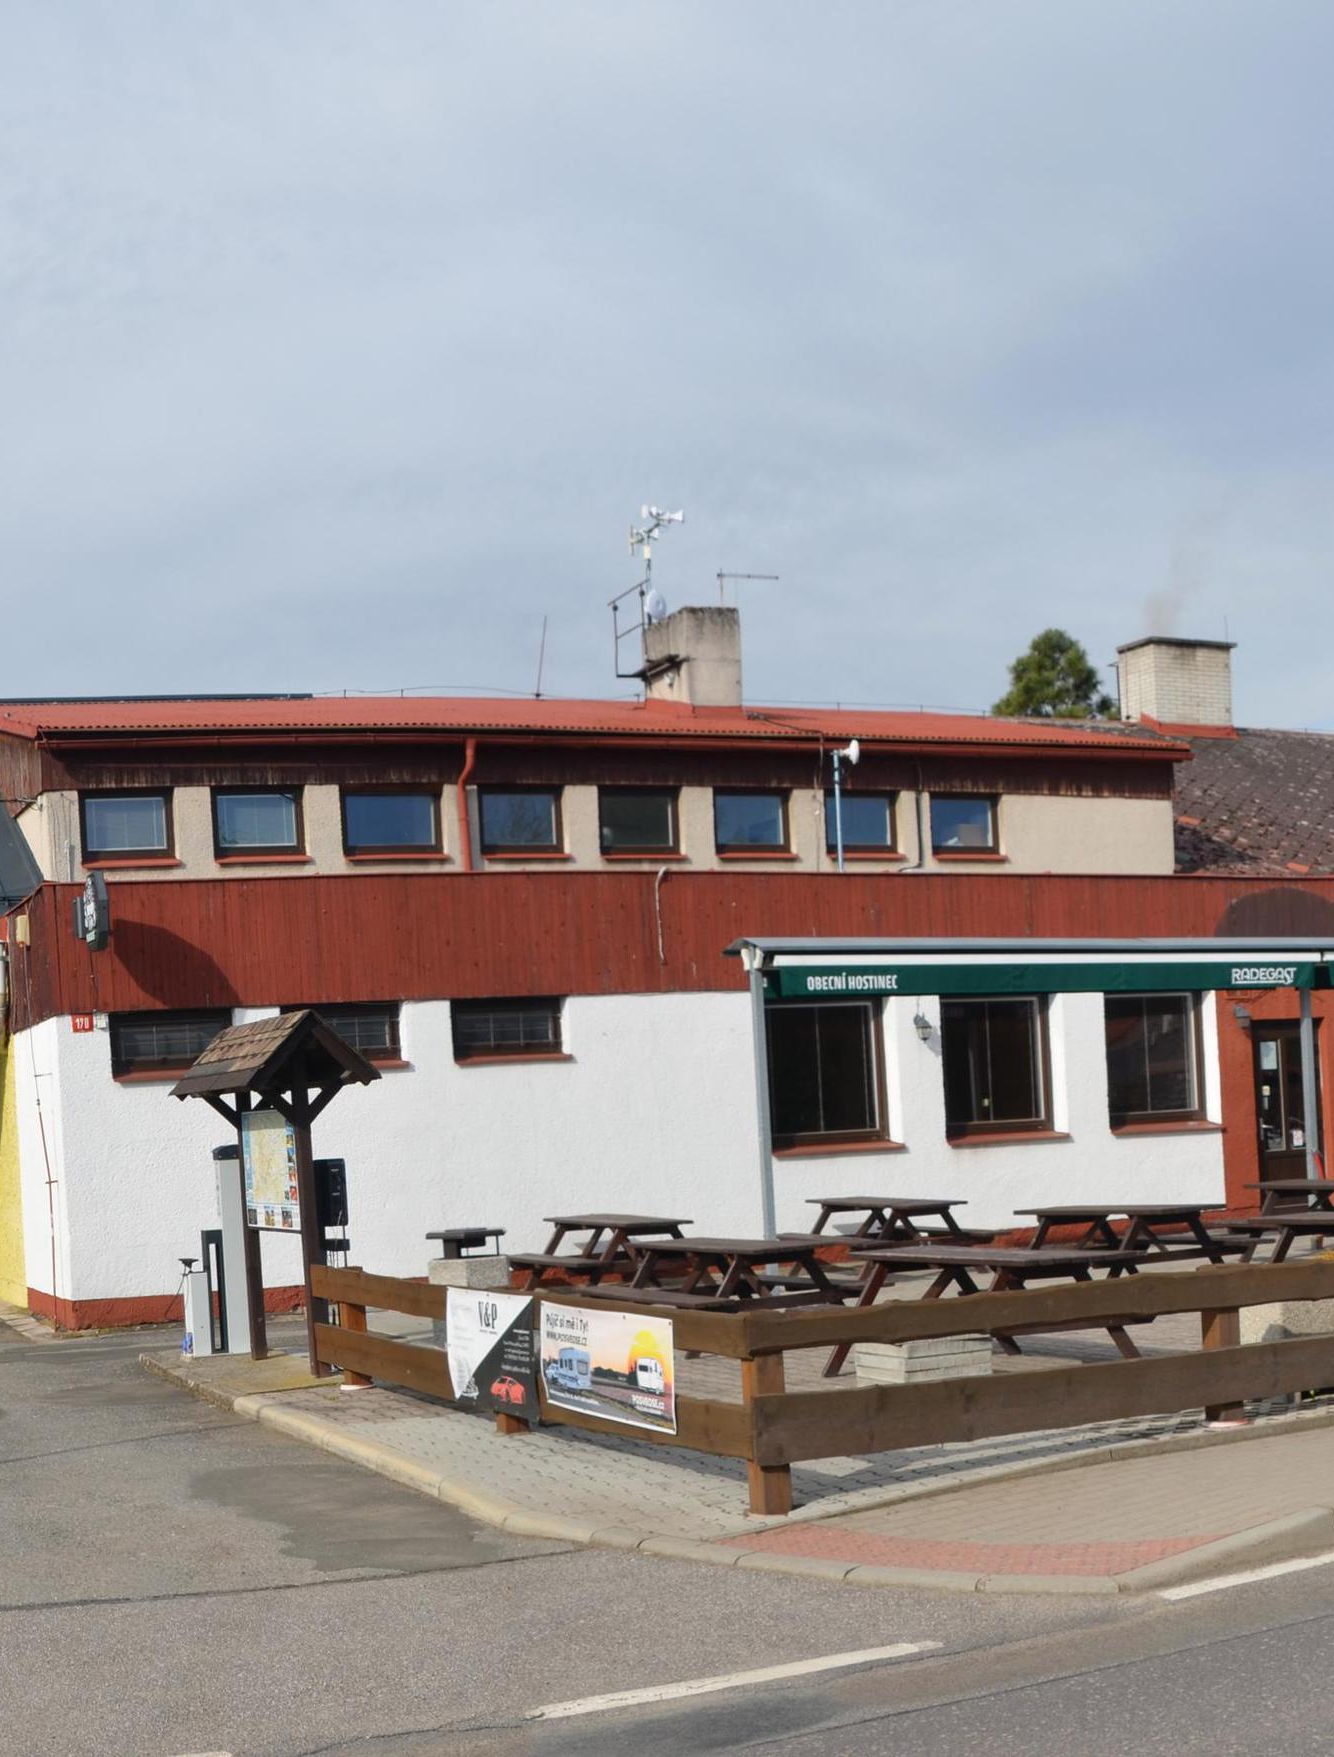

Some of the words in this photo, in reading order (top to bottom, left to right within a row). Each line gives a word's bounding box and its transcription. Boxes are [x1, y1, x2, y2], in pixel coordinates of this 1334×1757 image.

[807, 972, 846, 990] OBECNÍ
[848, 974, 898, 990] HOSTINEC
[1231, 967, 1296, 985] RADEGAST
[478, 1301, 498, 1329] V&P
